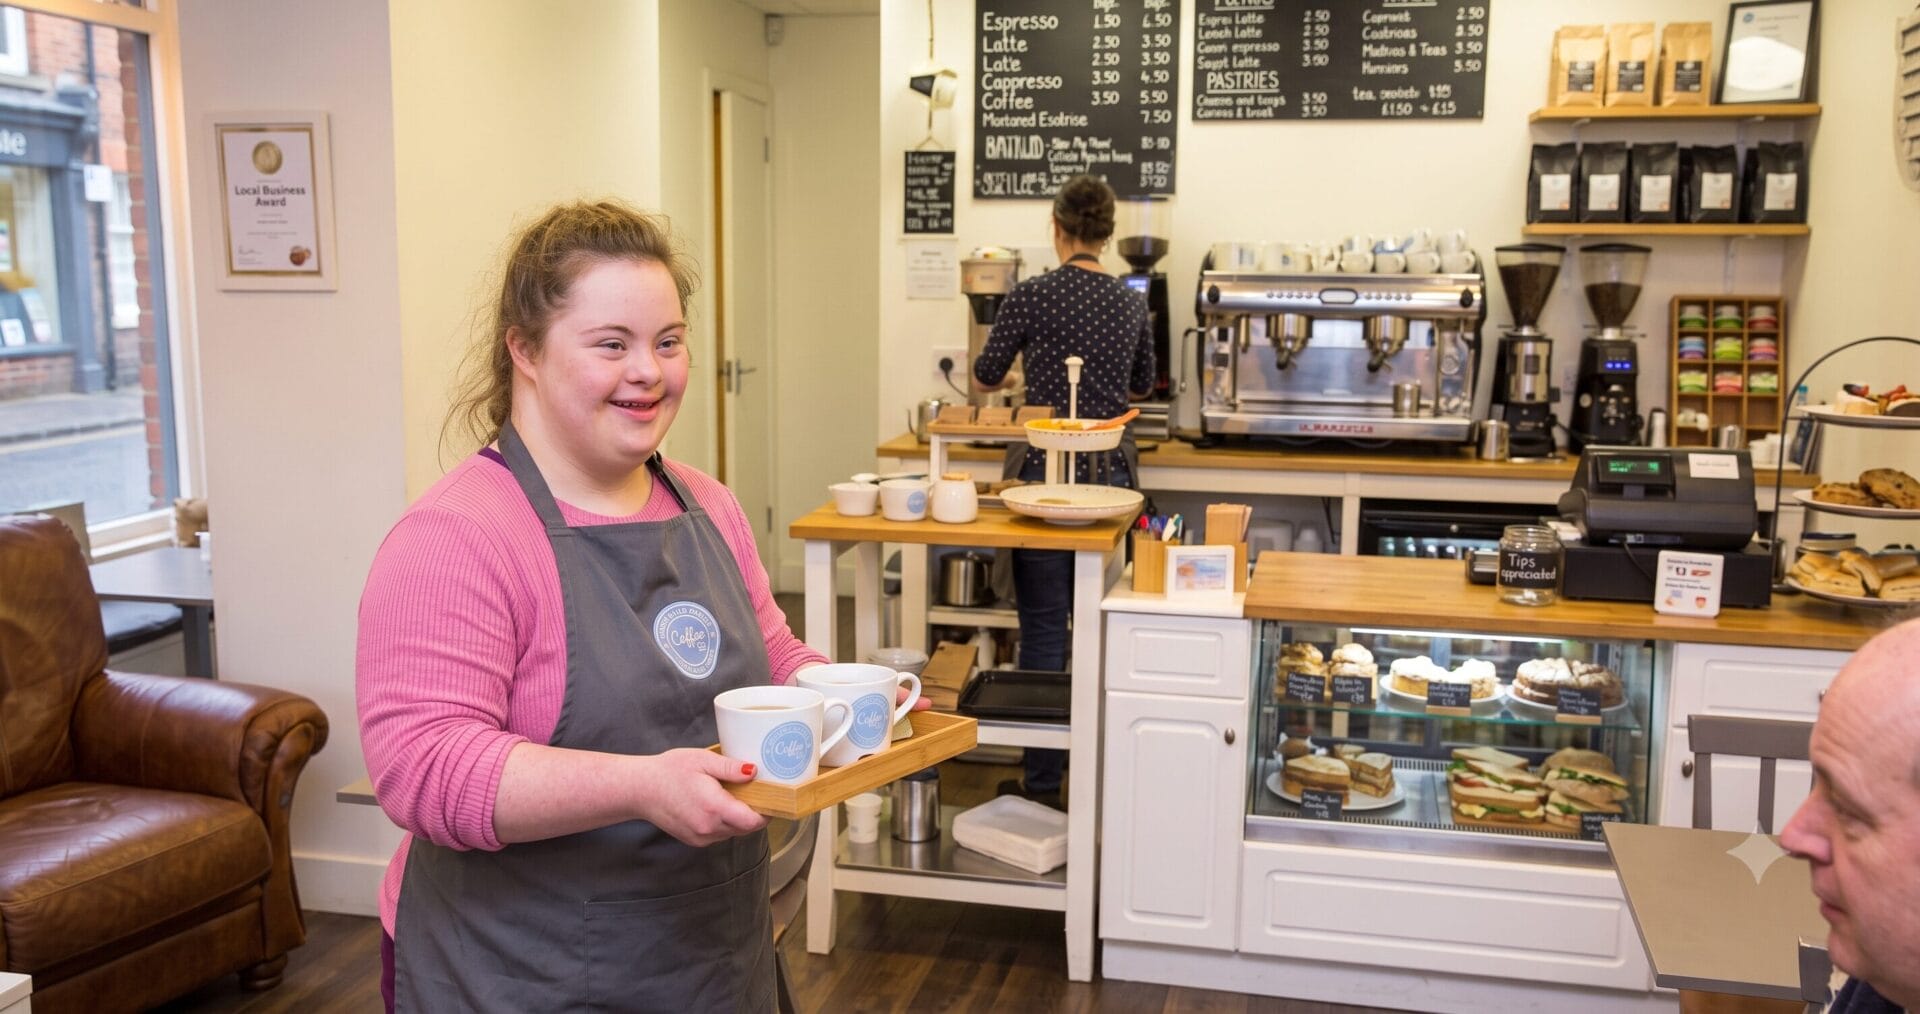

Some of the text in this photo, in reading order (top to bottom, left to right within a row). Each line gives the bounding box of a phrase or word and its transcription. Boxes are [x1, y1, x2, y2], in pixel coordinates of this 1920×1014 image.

[1456, 6, 1485, 21] 2.50
[983, 12, 1059, 36] Espresso
[983, 34, 1171, 53] Latte 2.50 3.50
[1419, 42, 1448, 56] Teas
[1092, 52, 1120, 66] 2.50
[1141, 51, 1171, 66] 3.50
[981, 70, 1170, 94] Cappresso 3.50 4.50
[1207, 70, 1280, 90] PASTRIES
[981, 90, 1168, 110] Coffee 3.50 5.50
[1140, 109, 1172, 124] 7.50
[235, 185, 306, 196] Local Business
[256, 197, 286, 207] Award
[1508, 553, 1536, 570] Tips
[1501, 566, 1556, 583] appreciated
[671, 626, 706, 648] Coffee
[857, 711, 883, 728] Coffee
[775, 740, 803, 757] Coffee
